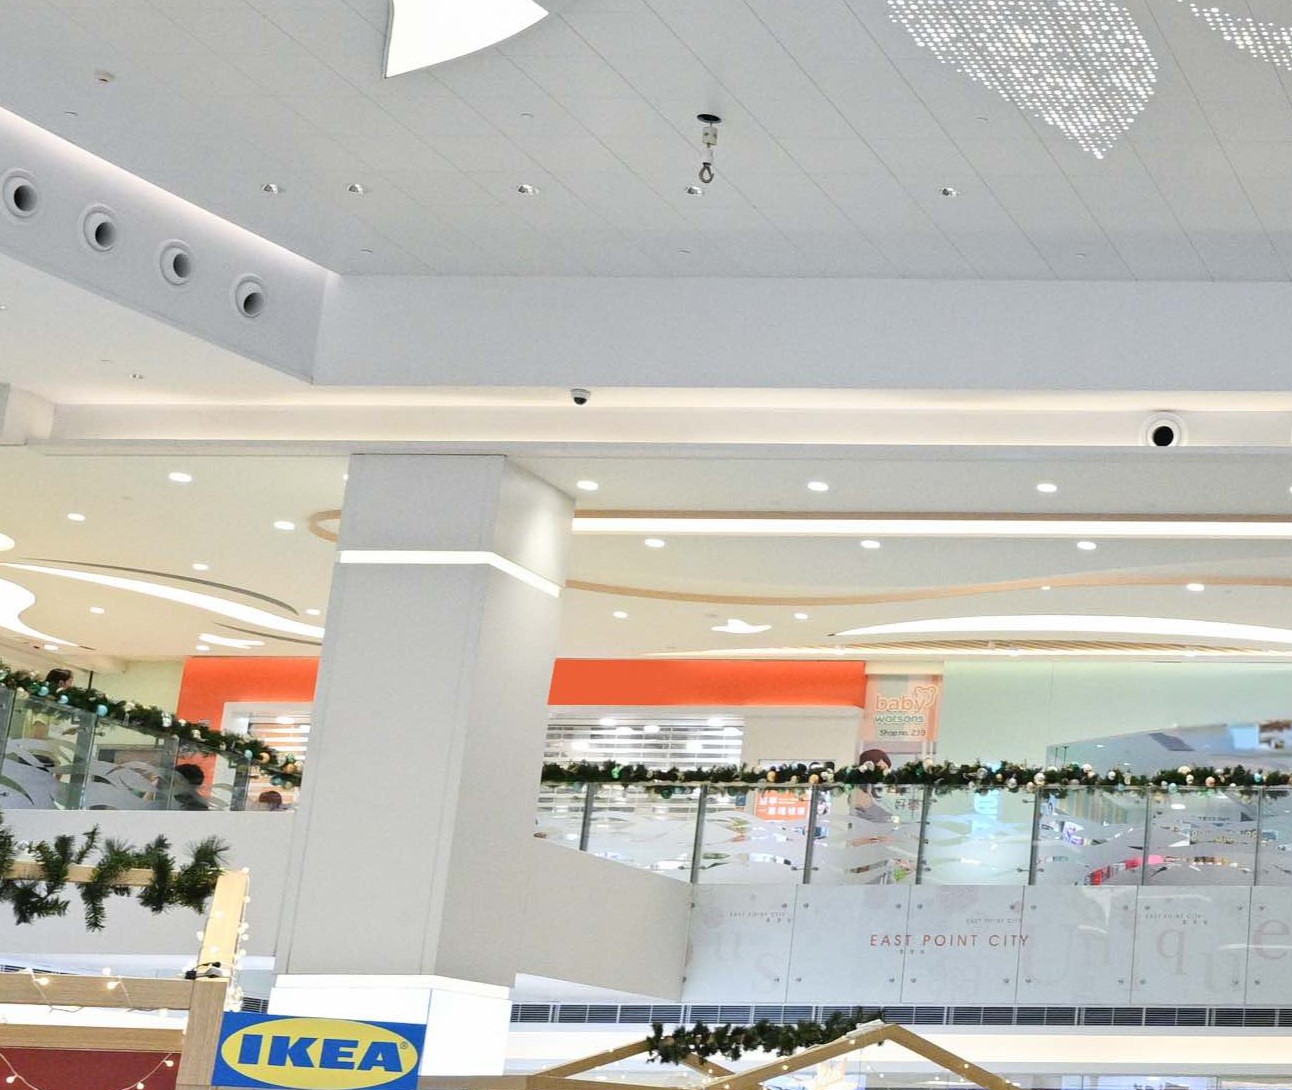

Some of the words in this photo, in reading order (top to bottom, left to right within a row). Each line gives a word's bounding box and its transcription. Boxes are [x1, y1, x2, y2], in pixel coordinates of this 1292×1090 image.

[876, 694, 924, 711] baby
[870, 934, 912, 947] EAST
[923, 934, 978, 947] POINT
[989, 934, 1029, 947] CITY
[238, 1034, 403, 1072] IKEA
